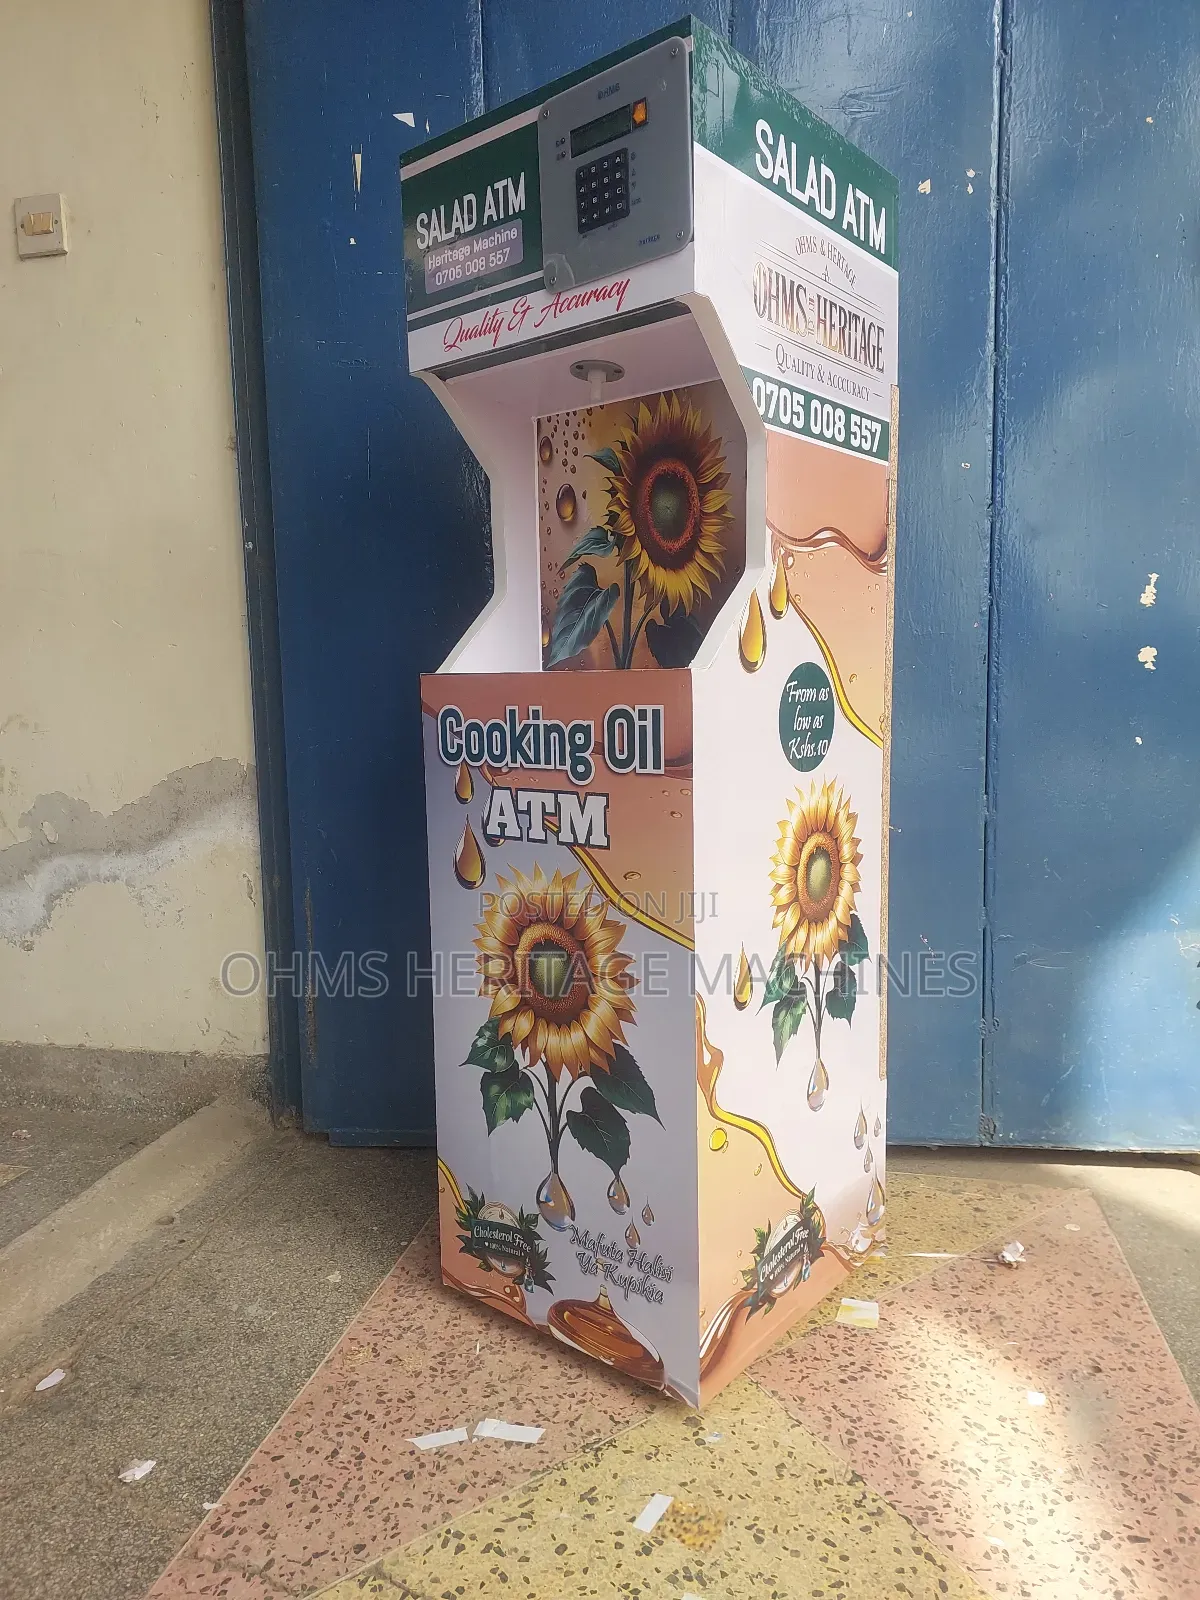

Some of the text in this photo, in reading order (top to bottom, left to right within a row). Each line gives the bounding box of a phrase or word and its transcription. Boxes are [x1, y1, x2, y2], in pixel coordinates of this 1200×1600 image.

[416, 171, 526, 250] SALAD ATM
[756, 118, 886, 255] SALAD ATM
[428, 227, 518, 270] Heritage Machine
[435, 247, 511, 286] 0705 008 557
[795, 235, 818, 256] OHMS
[820, 239, 826, 257] &
[443, 307, 507, 353] Quality
[533, 278, 631, 328] Accuracy
[753, 261, 808, 338] OHMS
[816, 292, 885, 375] HERITAGE
[816, 363, 825, 384] &
[752, 377, 882, 453] 0705 008 557
[786, 680, 830, 703] From as
[793, 704, 825, 731] low as
[437, 704, 665, 786] Cooking Oil
[788, 731, 829, 760] Kshs.10
[484, 786, 610, 850] ATM
[473, 1225, 532, 1253] Cholesterol Free
[501, 1244, 521, 1257] Natural
[569, 1224, 675, 1284] Mafuta Halisi
[760, 1226, 810, 1283] Cholesterol Free
[576, 1251, 665, 1304] Ya Kupikia
